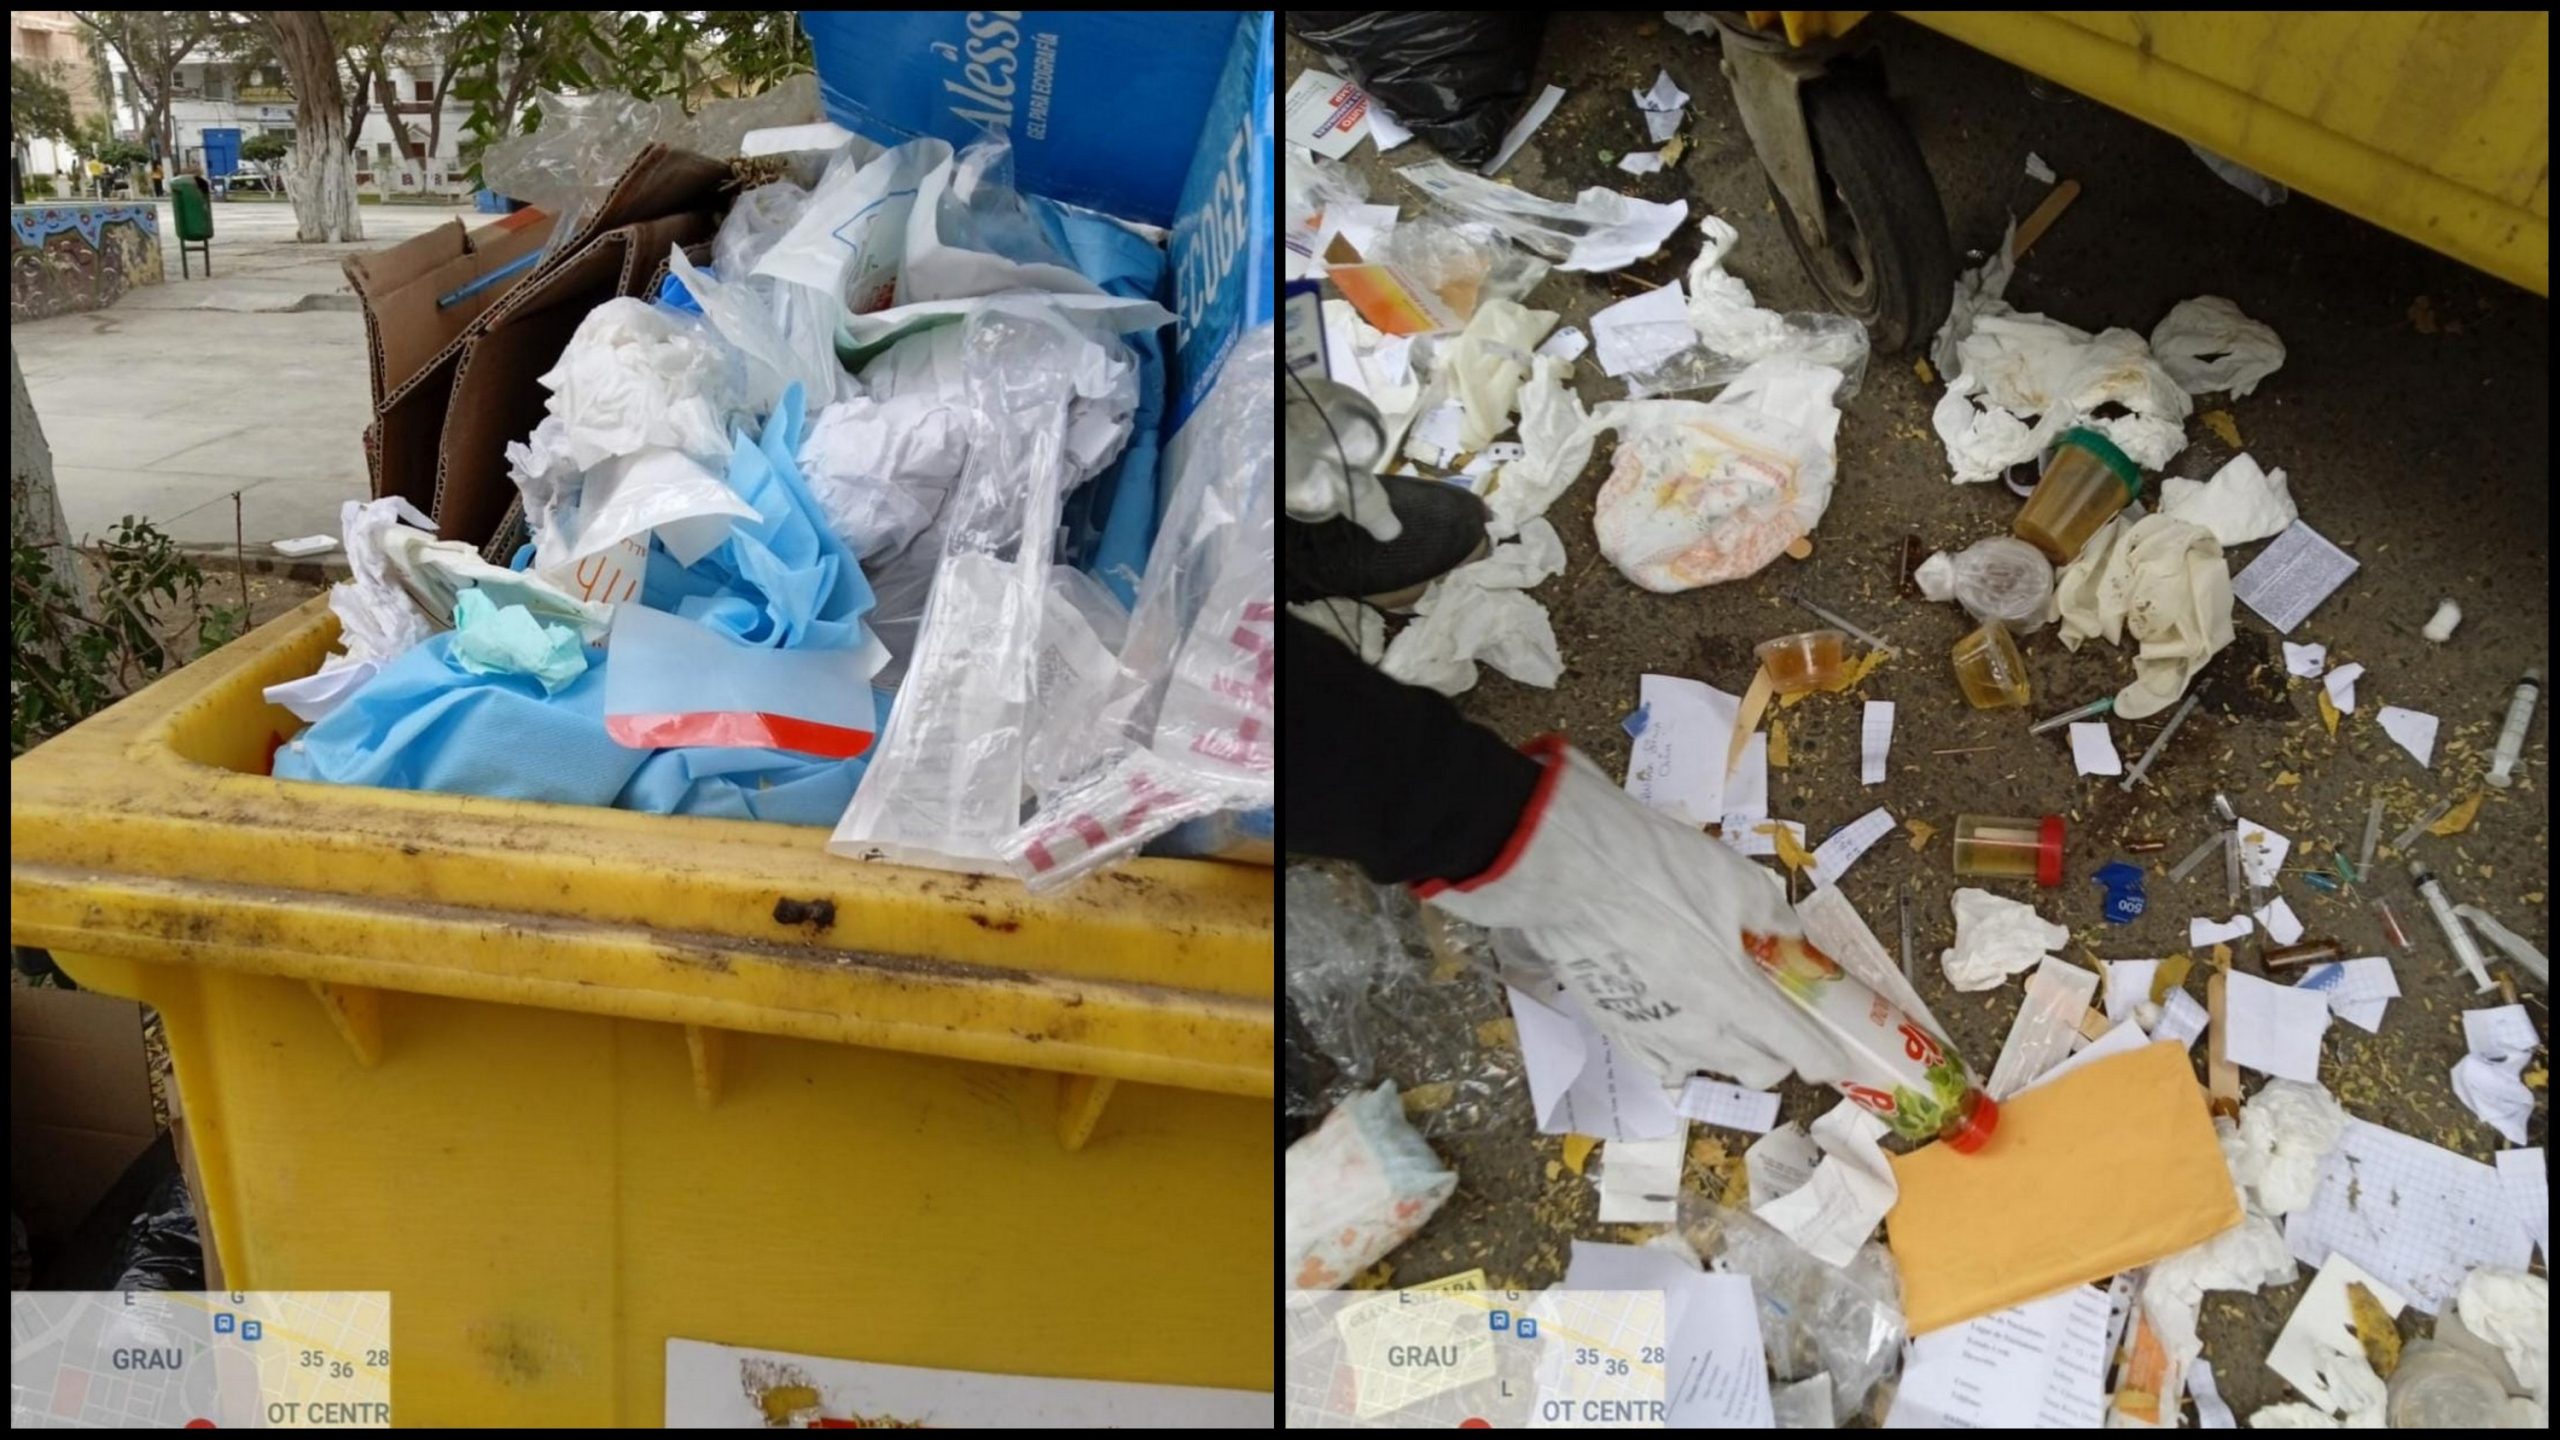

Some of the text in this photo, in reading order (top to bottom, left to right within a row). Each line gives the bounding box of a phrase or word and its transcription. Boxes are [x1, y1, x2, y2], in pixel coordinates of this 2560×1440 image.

[1029, 94, 1050, 121] PARA
[1027, 121, 1046, 140] GEL
[2117, 899, 2143, 914] 500
